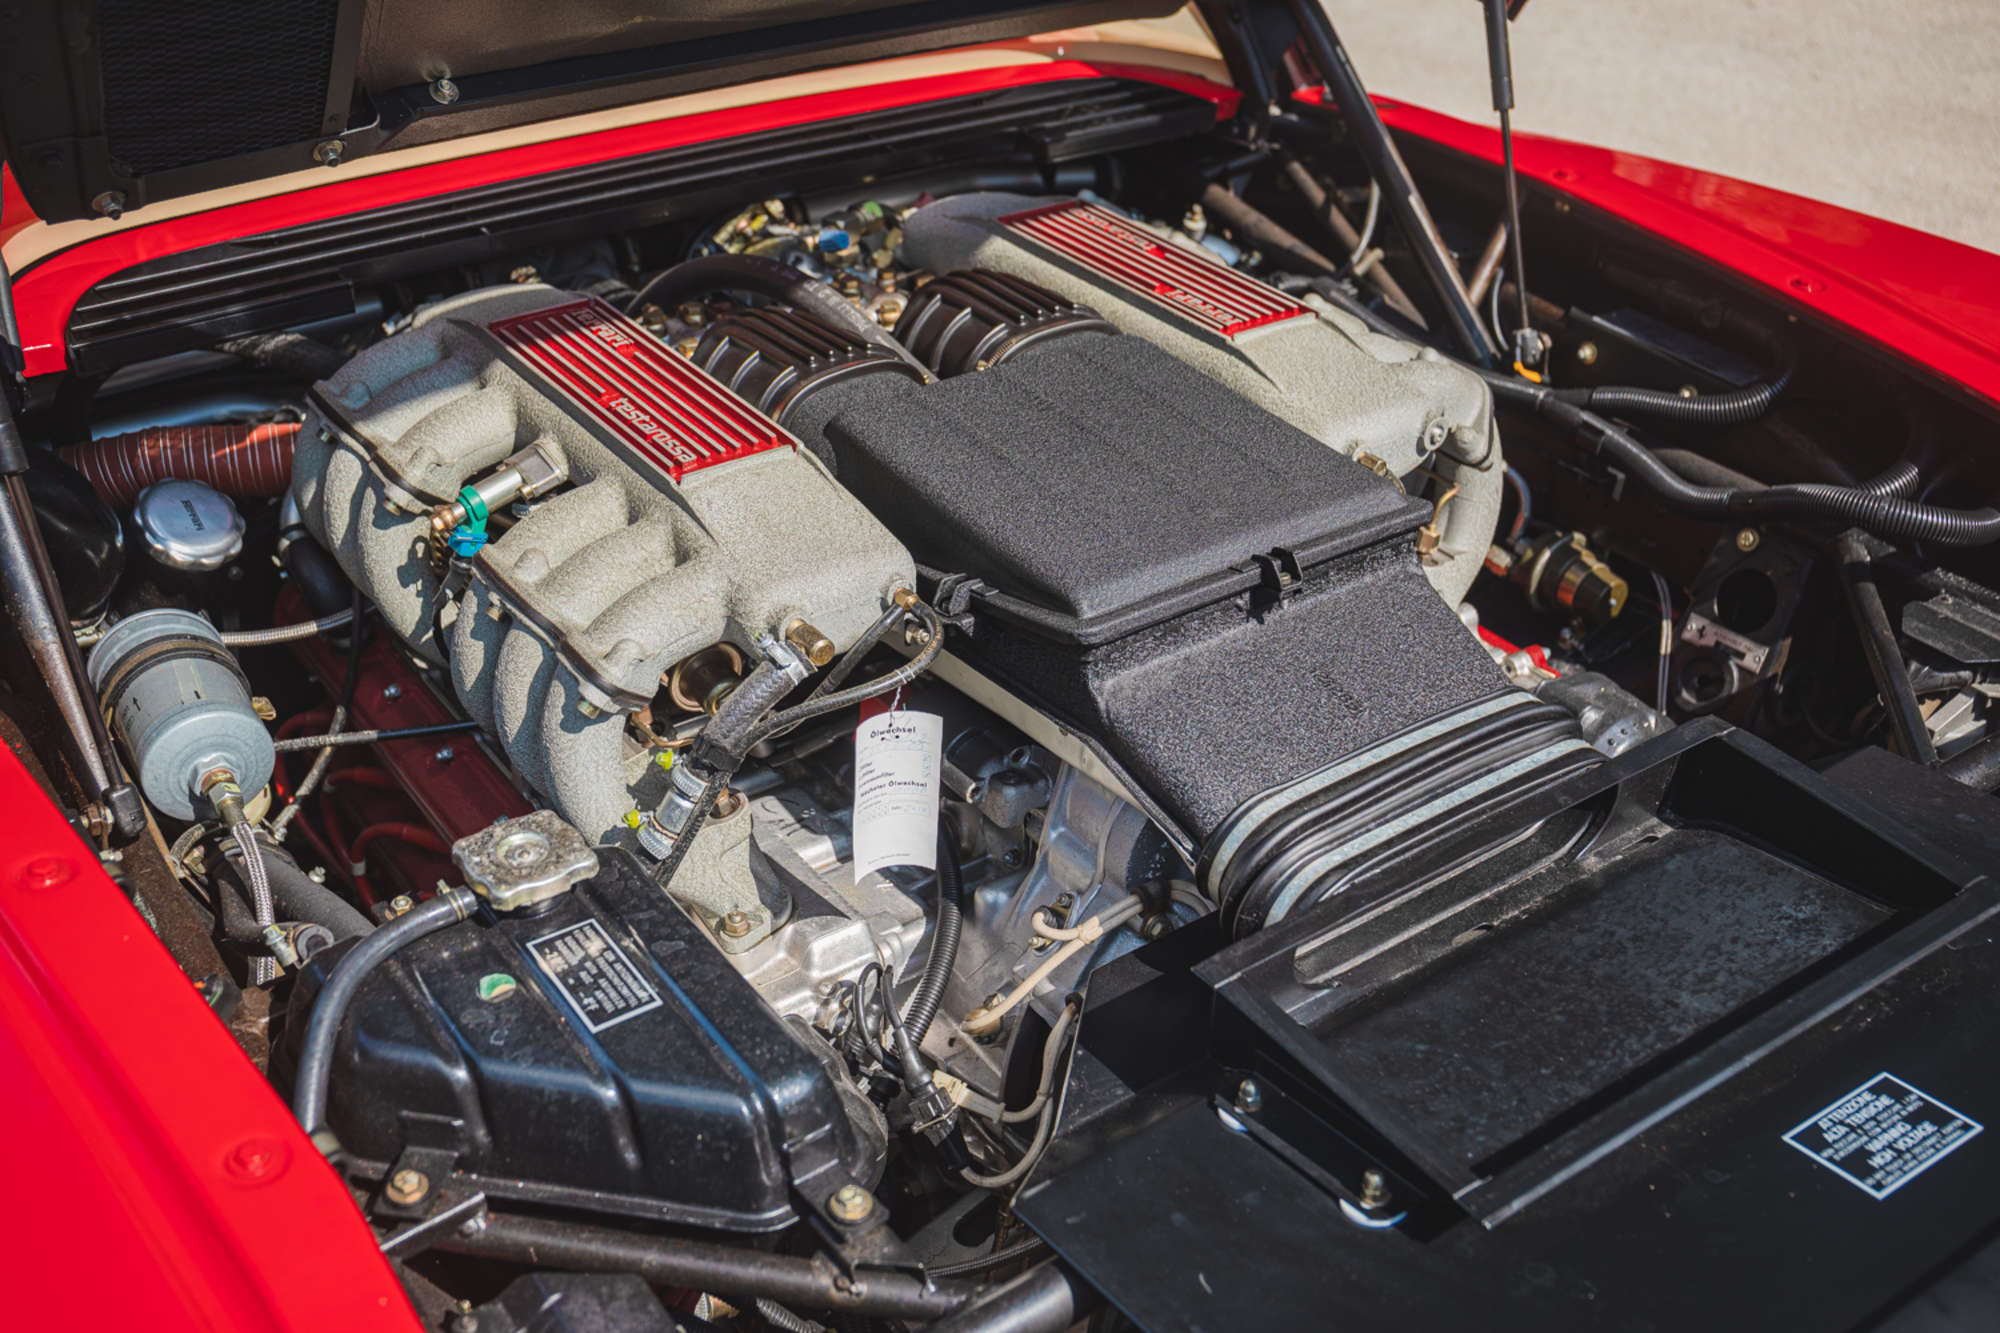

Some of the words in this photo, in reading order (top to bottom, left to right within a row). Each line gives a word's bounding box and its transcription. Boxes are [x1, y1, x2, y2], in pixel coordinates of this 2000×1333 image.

[609, 398, 698, 463] testarossa
[870, 726, 916, 738] Ölwechsel
[1817, 1091, 1877, 1130] ATTENZIONE
[1822, 1124, 1850, 1143] ALTA
[1844, 1094, 1895, 1127] TENSIONE
[1864, 1121, 1912, 1152] WARNING
[1892, 1120, 1938, 1150] VOLTAGE
